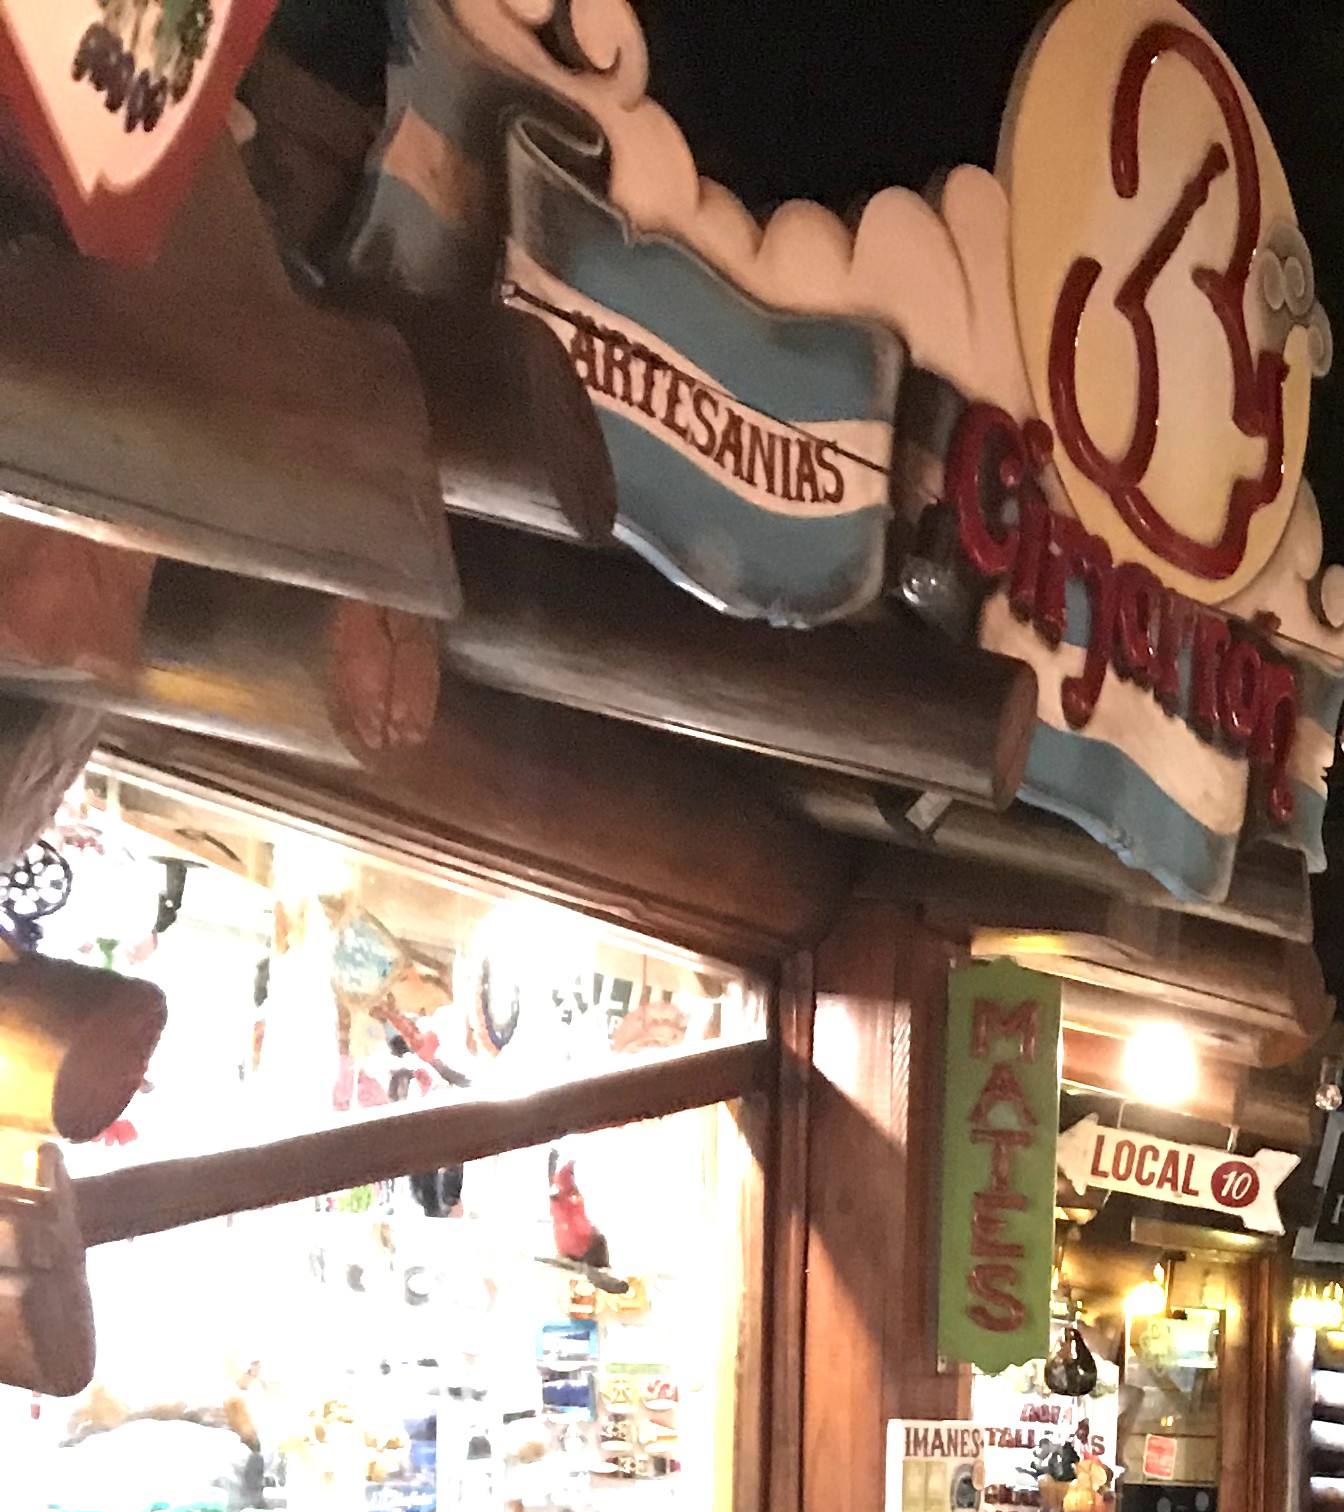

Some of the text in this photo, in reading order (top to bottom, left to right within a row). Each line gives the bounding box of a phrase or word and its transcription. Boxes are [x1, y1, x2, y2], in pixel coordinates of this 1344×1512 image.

[569, 316, 846, 504] ARTESANIAS
[967, 999, 1039, 1333] MATES
[1090, 1134, 1252, 1199] LOCAL 10
[905, 1427, 982, 1458] IMANES
